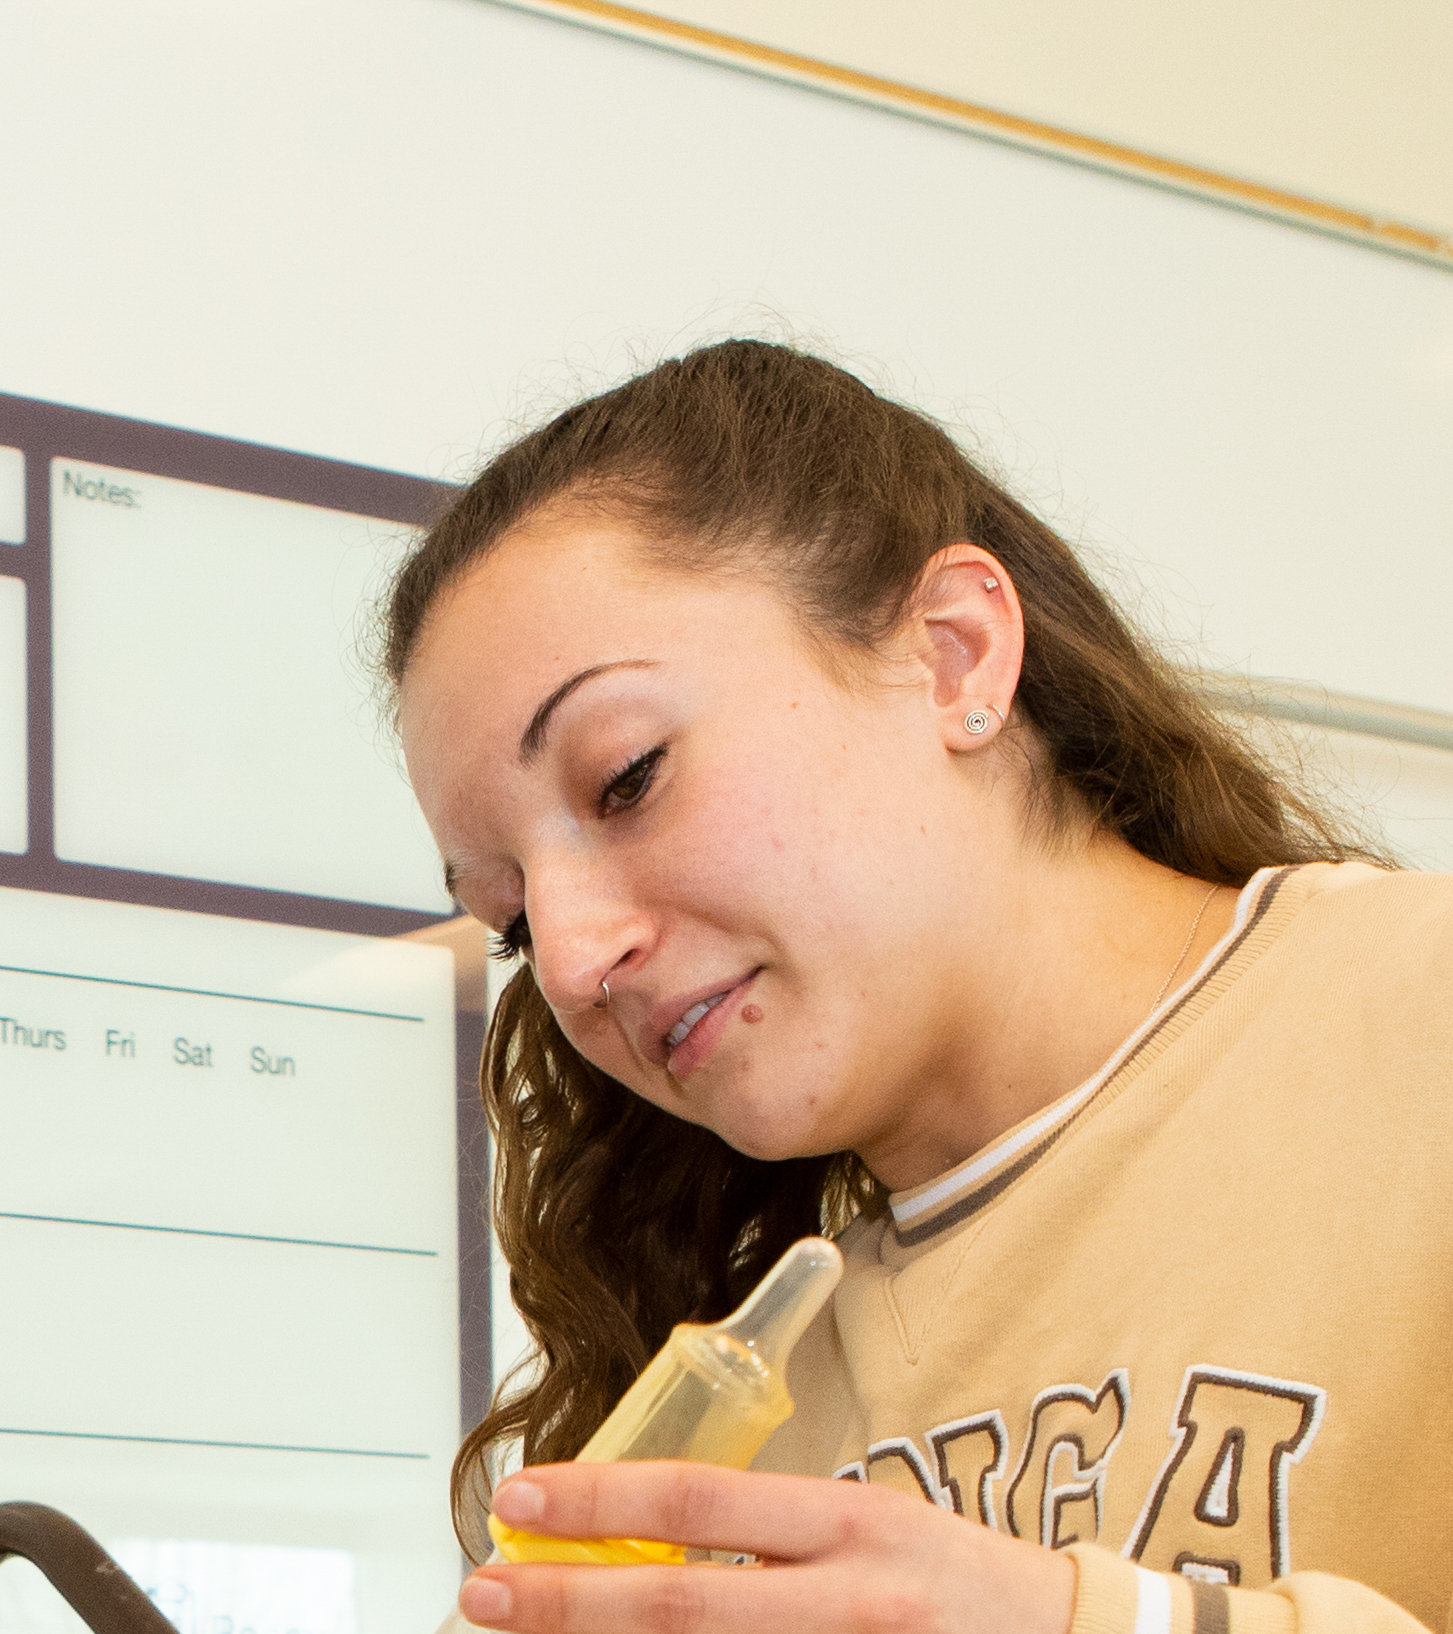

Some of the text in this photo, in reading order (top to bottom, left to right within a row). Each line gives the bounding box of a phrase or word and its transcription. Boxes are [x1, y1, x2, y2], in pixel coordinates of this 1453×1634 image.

[63, 469, 142, 508] Notes:
[105, 1029, 136, 1058] Fri
[174, 1037, 214, 1067] Sat
[250, 1046, 295, 1076] Sun
